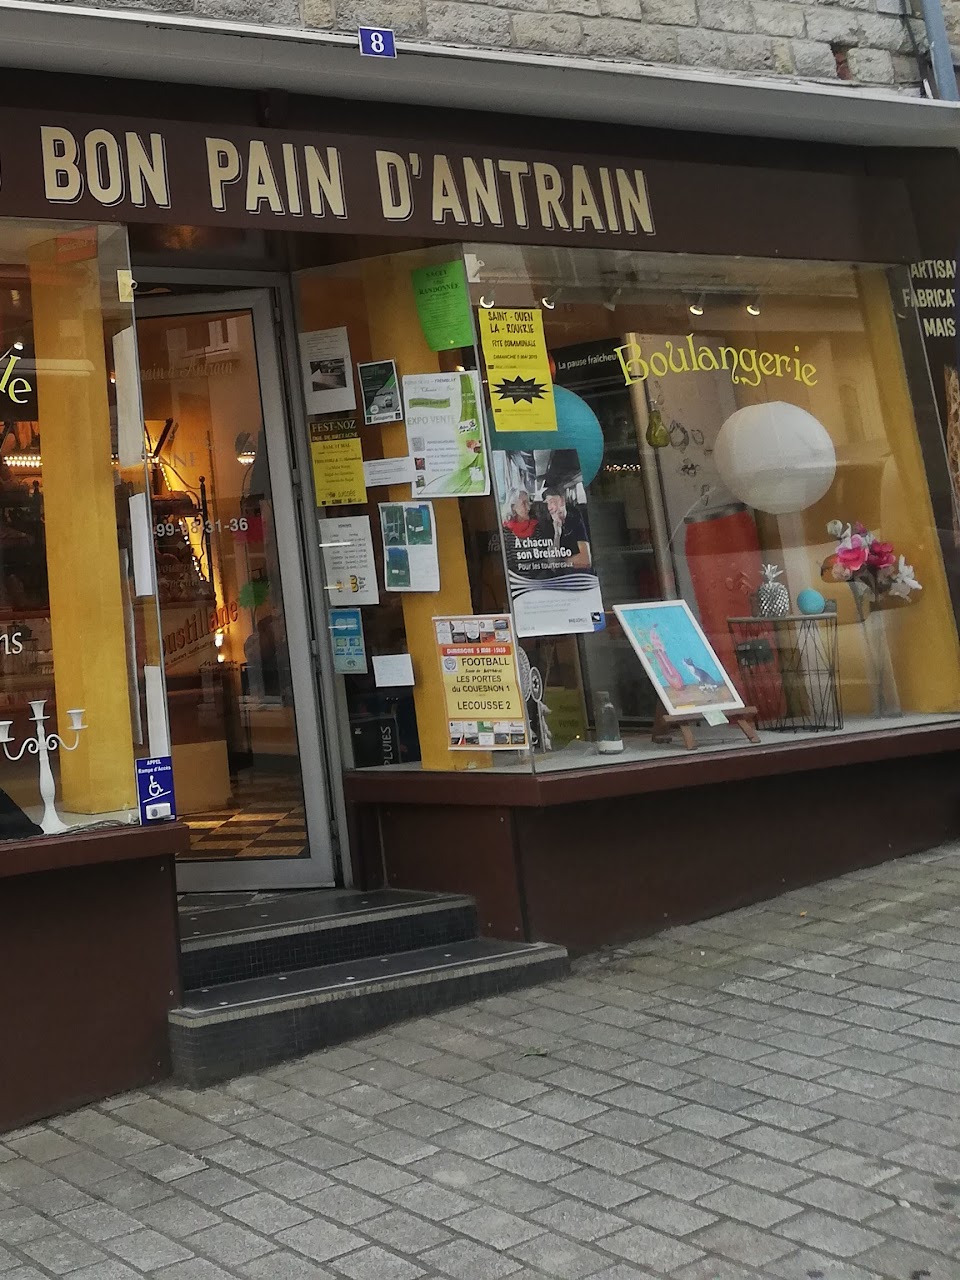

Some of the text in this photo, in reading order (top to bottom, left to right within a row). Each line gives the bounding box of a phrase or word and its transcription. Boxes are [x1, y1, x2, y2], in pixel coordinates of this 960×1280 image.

[368, 32, 385, 54] 8
[40, 126, 172, 209] BON
[206, 137, 348, 219] PAIN
[375, 150, 657, 236] D'ANTRAIN
[902, 288, 956, 308] FABRICA
[923, 317, 957, 337] MAIS
[567, 359, 587, 370] pause
[588, 353, 619, 365] fraîcheu
[613, 333, 818, 387] Boulangerie
[311, 419, 357, 433] FEST-NOZ
[523, 538, 553, 548] chacun
[516, 547, 572, 560] son BreizhGo
[461, 657, 510, 666] FOOTBALL
[472, 675, 502, 683] PORTES
[462, 685, 504, 693] COUESNON
[458, 700, 511, 710] LECOUSSE 2
